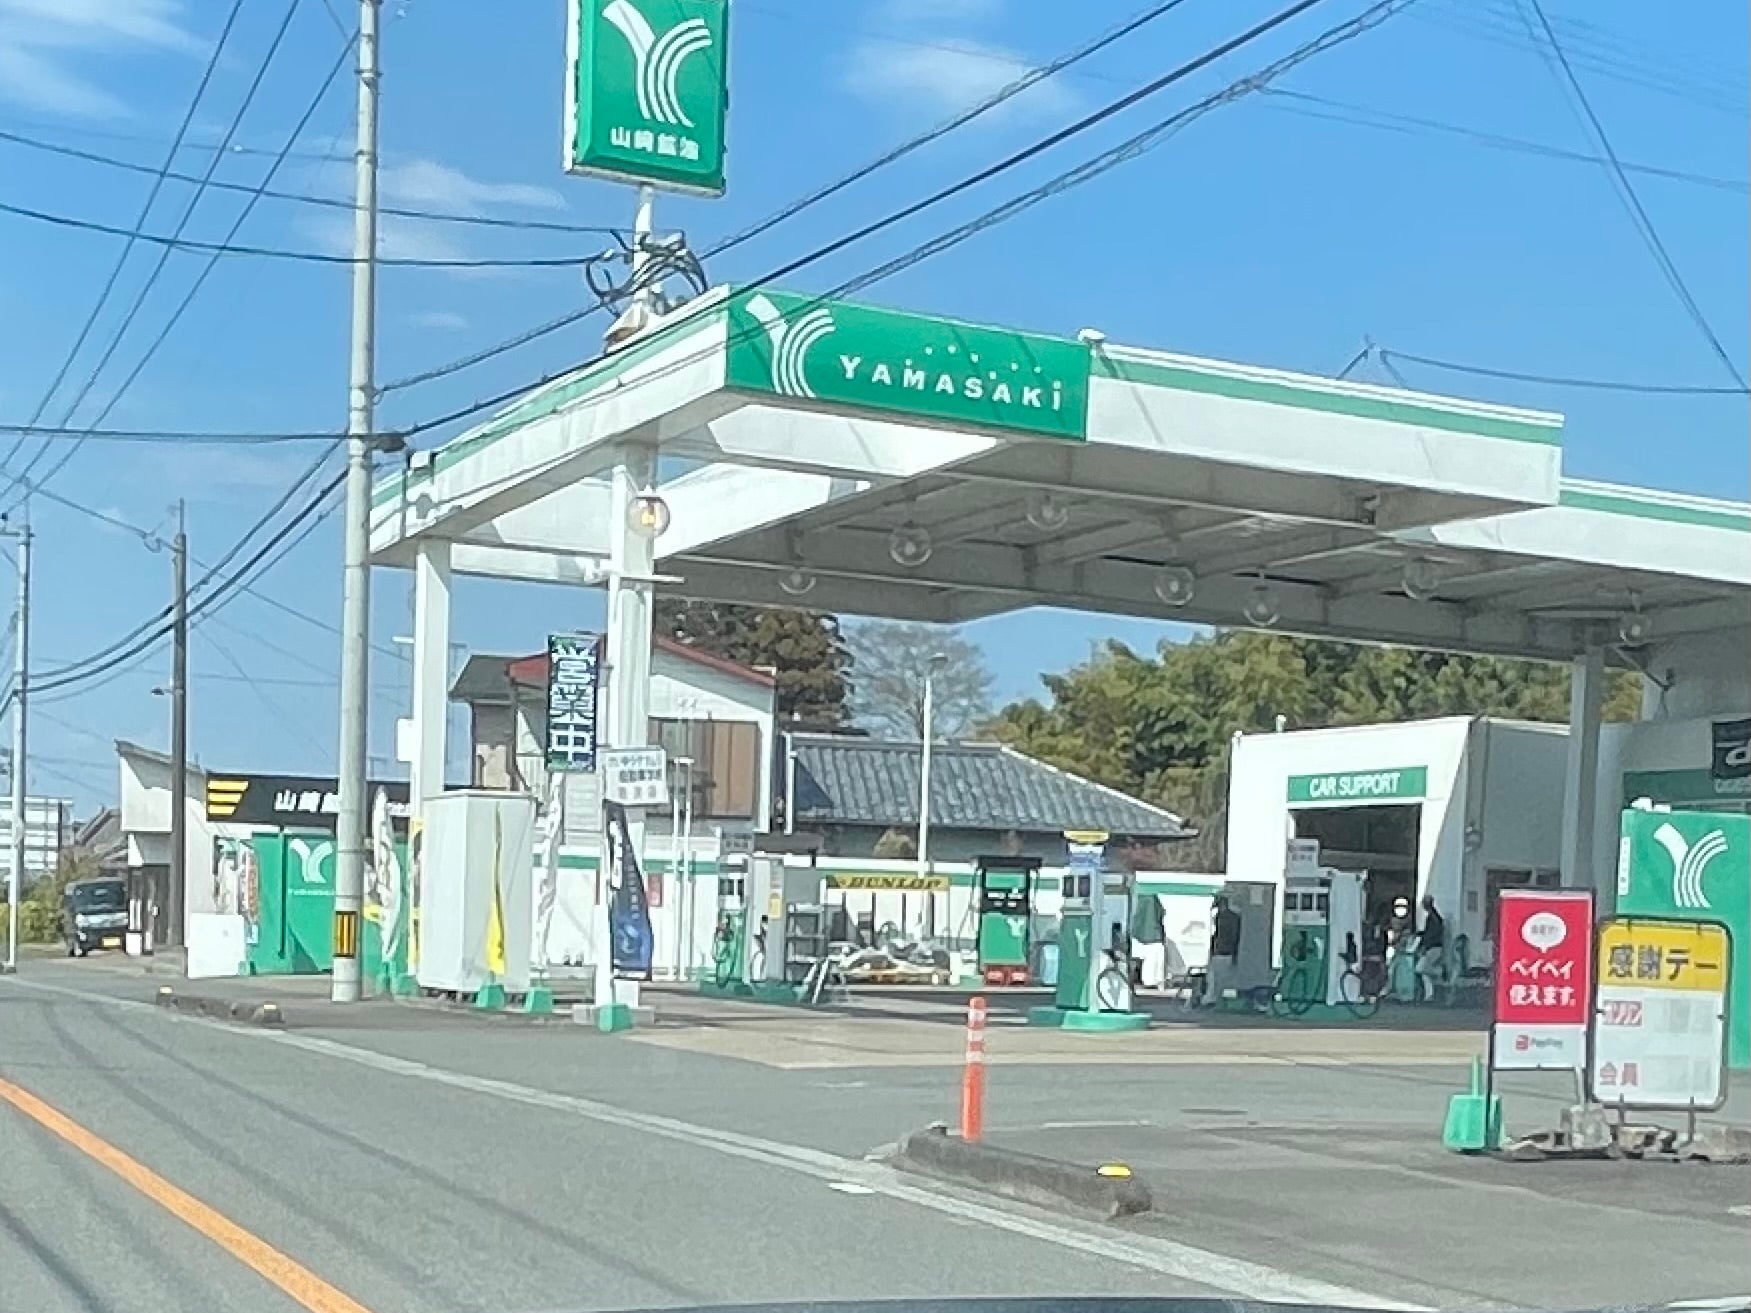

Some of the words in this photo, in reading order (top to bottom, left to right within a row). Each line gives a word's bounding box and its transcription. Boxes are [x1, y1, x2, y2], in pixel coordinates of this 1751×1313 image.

[1309, 777, 1336, 797] CAR
[1339, 772, 1400, 796] SUPPORT
[849, 876, 942, 889] DUNLOP
[1607, 944, 1719, 981] 感謝デー
[1599, 1061, 1638, 1087] 会員
